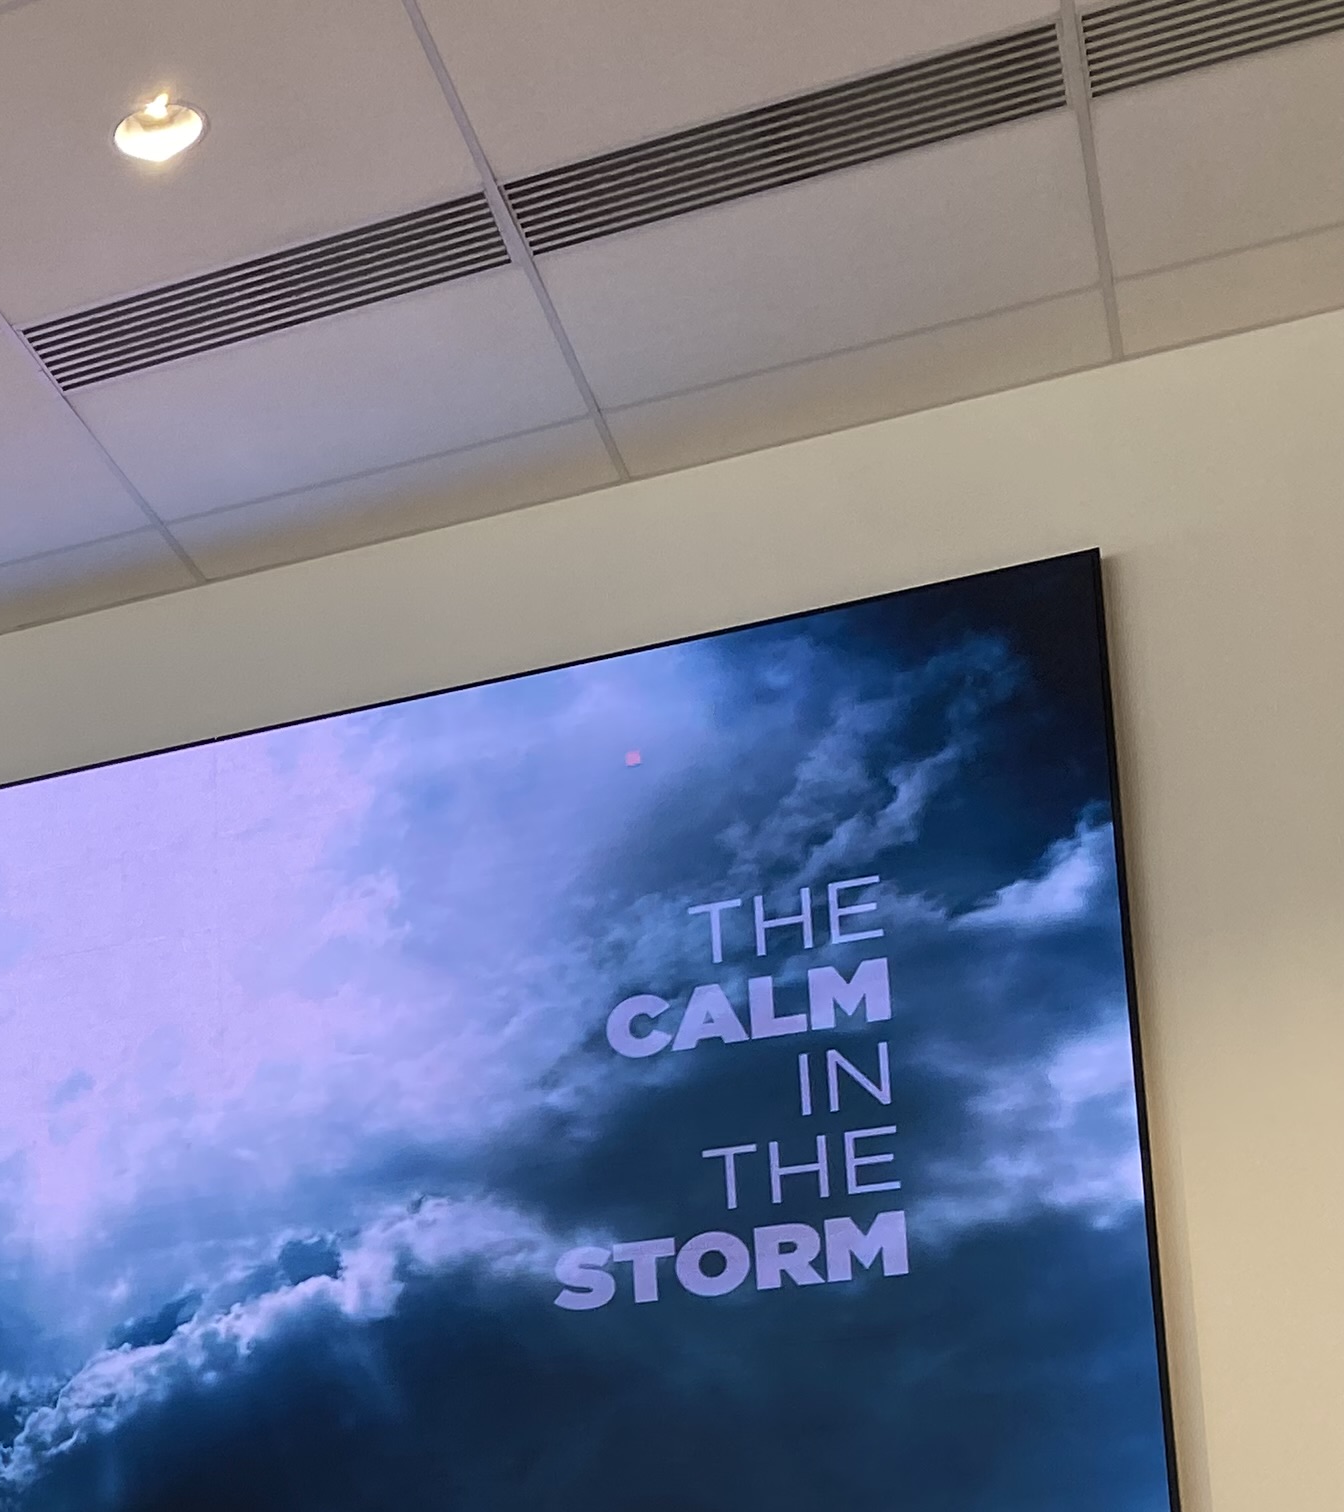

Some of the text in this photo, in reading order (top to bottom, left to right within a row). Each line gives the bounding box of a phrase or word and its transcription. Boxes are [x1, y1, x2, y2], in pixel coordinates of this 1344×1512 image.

[688, 875, 885, 963] THE
[606, 957, 892, 1058] CALM
[798, 1041, 892, 1116] IN
[702, 1125, 902, 1209] THE
[554, 1210, 909, 1310] STORM
